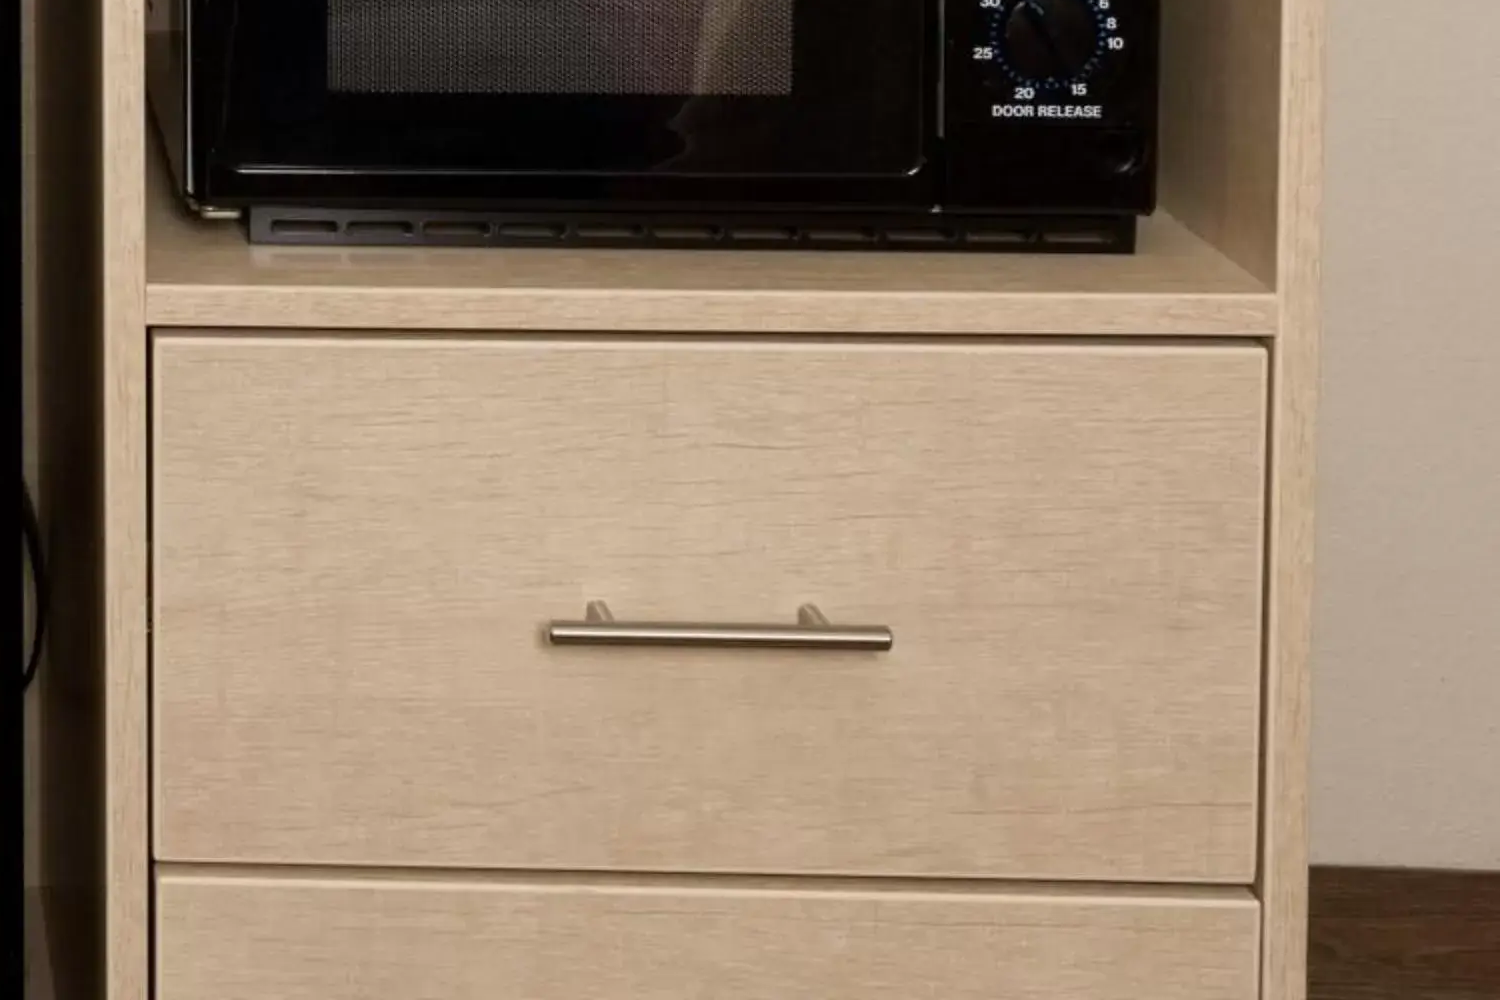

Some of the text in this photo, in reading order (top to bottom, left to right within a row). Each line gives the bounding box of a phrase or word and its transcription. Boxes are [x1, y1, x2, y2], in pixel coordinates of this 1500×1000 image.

[1106, 17, 1117, 29] 8
[1107, 37, 1124, 50] 10
[972, 47, 993, 60] 25
[1013, 87, 1035, 100] 20
[1071, 83, 1087, 96] 15
[992, 105, 1102, 118] DOOR RELEASE
